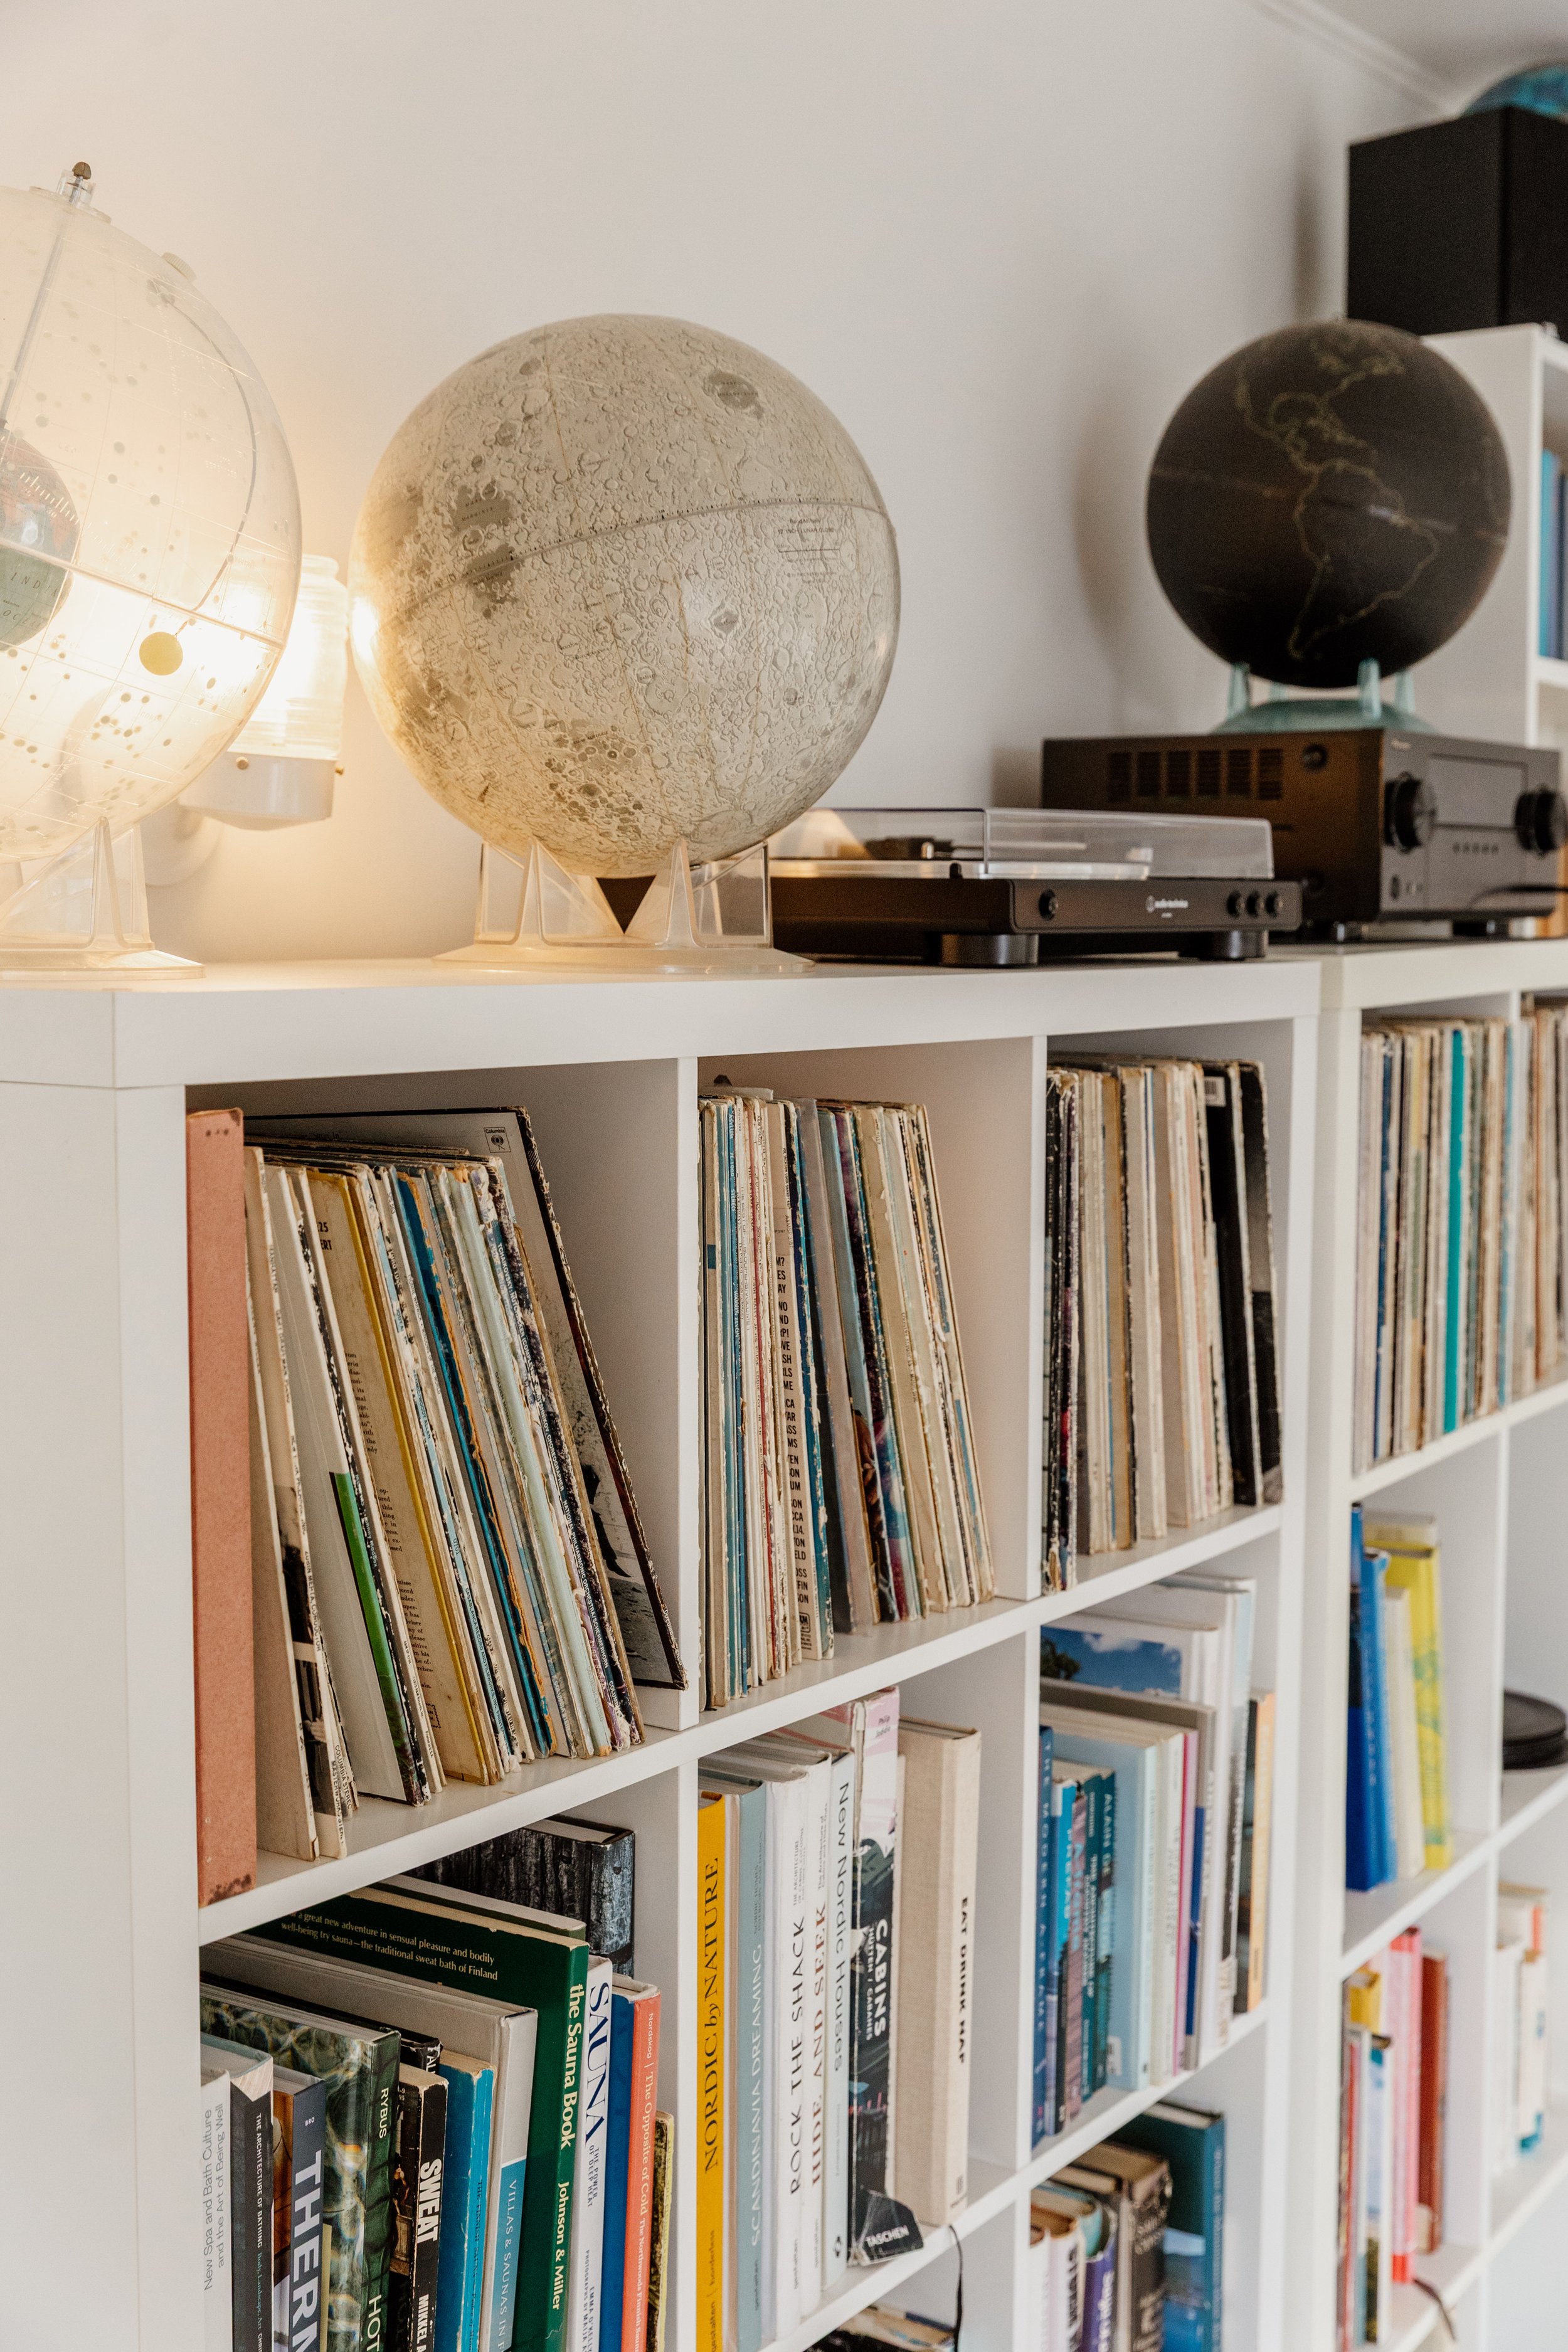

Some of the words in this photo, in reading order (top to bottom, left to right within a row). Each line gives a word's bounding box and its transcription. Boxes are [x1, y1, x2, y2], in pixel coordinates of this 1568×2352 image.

[413, 1297, 422, 1321] WARWICK
[494, 1372, 504, 1400] GOLDEN
[501, 1402, 512, 1435] MOMENTS
[511, 1437, 516, 1445] OF
[546, 1434, 563, 1491] CHOREOGRAPHER
[563, 1500, 575, 1531] NATIONAL
[570, 1532, 585, 1579] PHILHARMONIC
[369, 1540, 378, 1567] Maddox
[465, 1587, 478, 1627] CASABLANCA
[475, 1628, 484, 1651] RECORD
[480, 1652, 488, 1663] AND
[335, 1745, 347, 1781] COLUMBIA
[837, 1782, 850, 1847] New
[704, 1858, 719, 1998] NATURE
[835, 1857, 848, 1954] Nordic
[960, 1897, 969, 1934] EAT
[282, 1923, 318, 1939] well-being
[320, 1931, 329, 1941] try
[375, 1944, 413, 1960] traditional
[415, 1954, 437, 1966] sweat
[439, 1958, 457, 1971] bath
[458, 1964, 467, 1972] of
[469, 1966, 498, 1980] Finland
[304, 1914, 322, 1924] great
[324, 1919, 339, 1927] new
[342, 1920, 378, 1936] adventure
[380, 1929, 387, 1939] in
[389, 1932, 416, 1946] sensual
[419, 1940, 450, 1954] pleasure
[453, 1947, 467, 1957] and
[469, 1950, 494, 1965] bodily
[815, 1902, 825, 1996] SEEK
[792, 1916, 804, 2022] SHACK
[874, 1919, 888, 2037] CABINS
[959, 1945, 969, 2015] DRINK
[569, 1984, 584, 2018] the
[704, 2001, 721, 2028] by
[750, 1944, 762, 2076] DREAMING
[834, 1959, 845, 2072] Houses
[564, 2023, 581, 2089] Sauna
[585, 1982, 609, 2147] SAUNA
[791, 2033, 803, 2095] THE
[813, 2009, 824, 2078] AND
[645, 2071, 654, 2100] The
[704, 2032, 719, 2172] NORDIC
[203, 2109, 212, 2160] Culture
[215, 2104, 224, 2131] Well
[305, 2117, 315, 2126] BRO
[379, 2087, 389, 2139] RYBUS
[561, 2094, 578, 2149] Book
[642, 2102, 652, 2164] Opposite
[216, 2132, 225, 2171] Being
[589, 2145, 595, 2154] OF
[642, 2166, 650, 2180] of
[751, 2079, 761, 2246] SCANDINAVIA
[790, 2104, 802, 2194] ROCK
[203, 2164, 213, 2196] Bath
[216, 2175, 223, 2187] of
[257, 2198, 262, 2208] OF
[416, 2158, 442, 2242] SWEAT
[640, 2183, 649, 2215] Cold
[203, 2199, 213, 2224] and
[506, 2180, 517, 2234] VILLAS
[556, 2182, 569, 2245] Johnson
[204, 2228, 214, 2256] Spa
[216, 2242, 225, 2268] and
[504, 2239, 512, 2249] &
[555, 2249, 566, 2261] &
[865, 2225, 909, 2248] TASCHEN
[204, 2259, 213, 2291] New
[500, 2252, 511, 2314] SAUNAS
[552, 2265, 565, 2309] Miller
[636, 2238, 645, 2291] Northwoods
[416, 2294, 429, 2343] MIKKEL
[498, 2320, 506, 2336] IN
